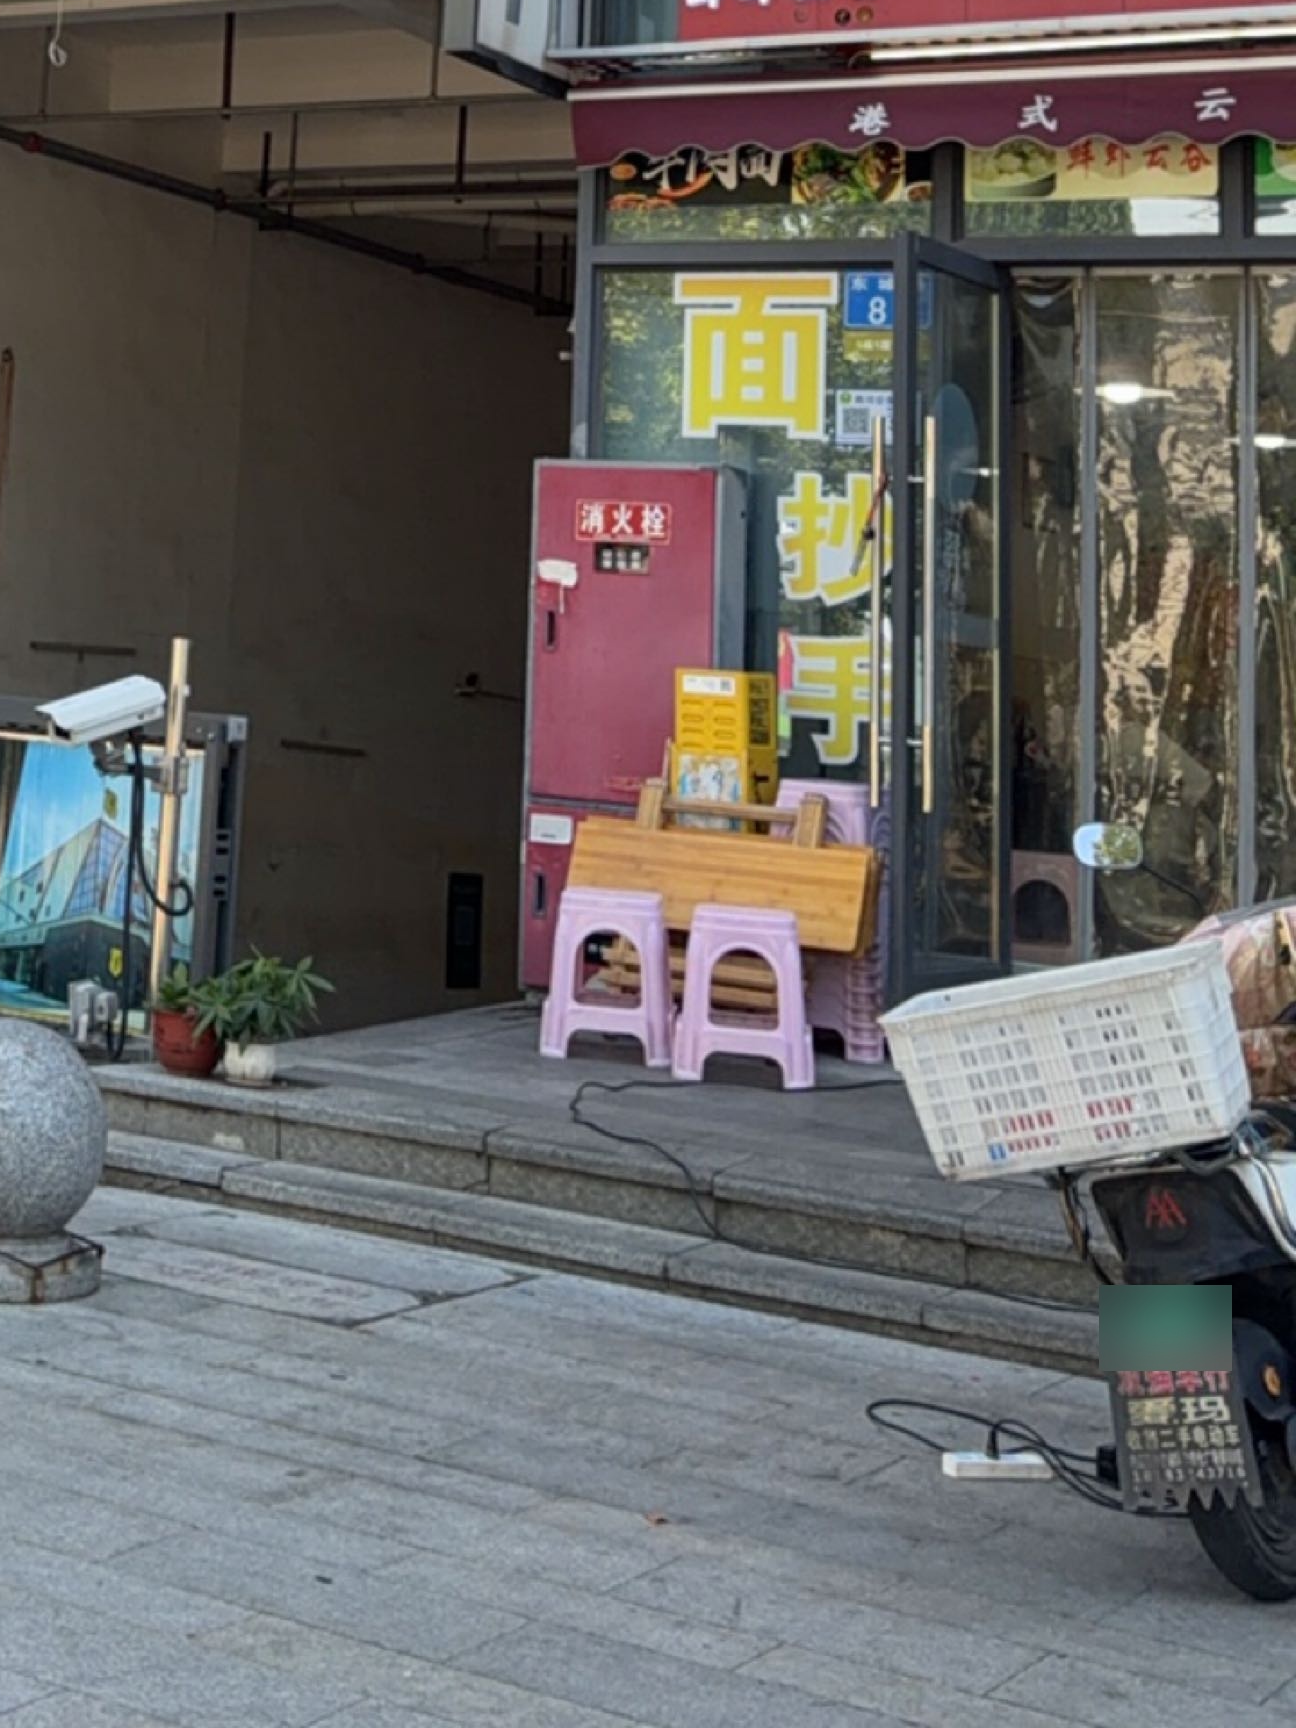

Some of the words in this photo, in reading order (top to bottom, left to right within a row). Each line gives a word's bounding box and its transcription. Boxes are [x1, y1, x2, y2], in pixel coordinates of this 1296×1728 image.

[674, 271, 839, 440] 面
[579, 503, 666, 538] 消火栓
